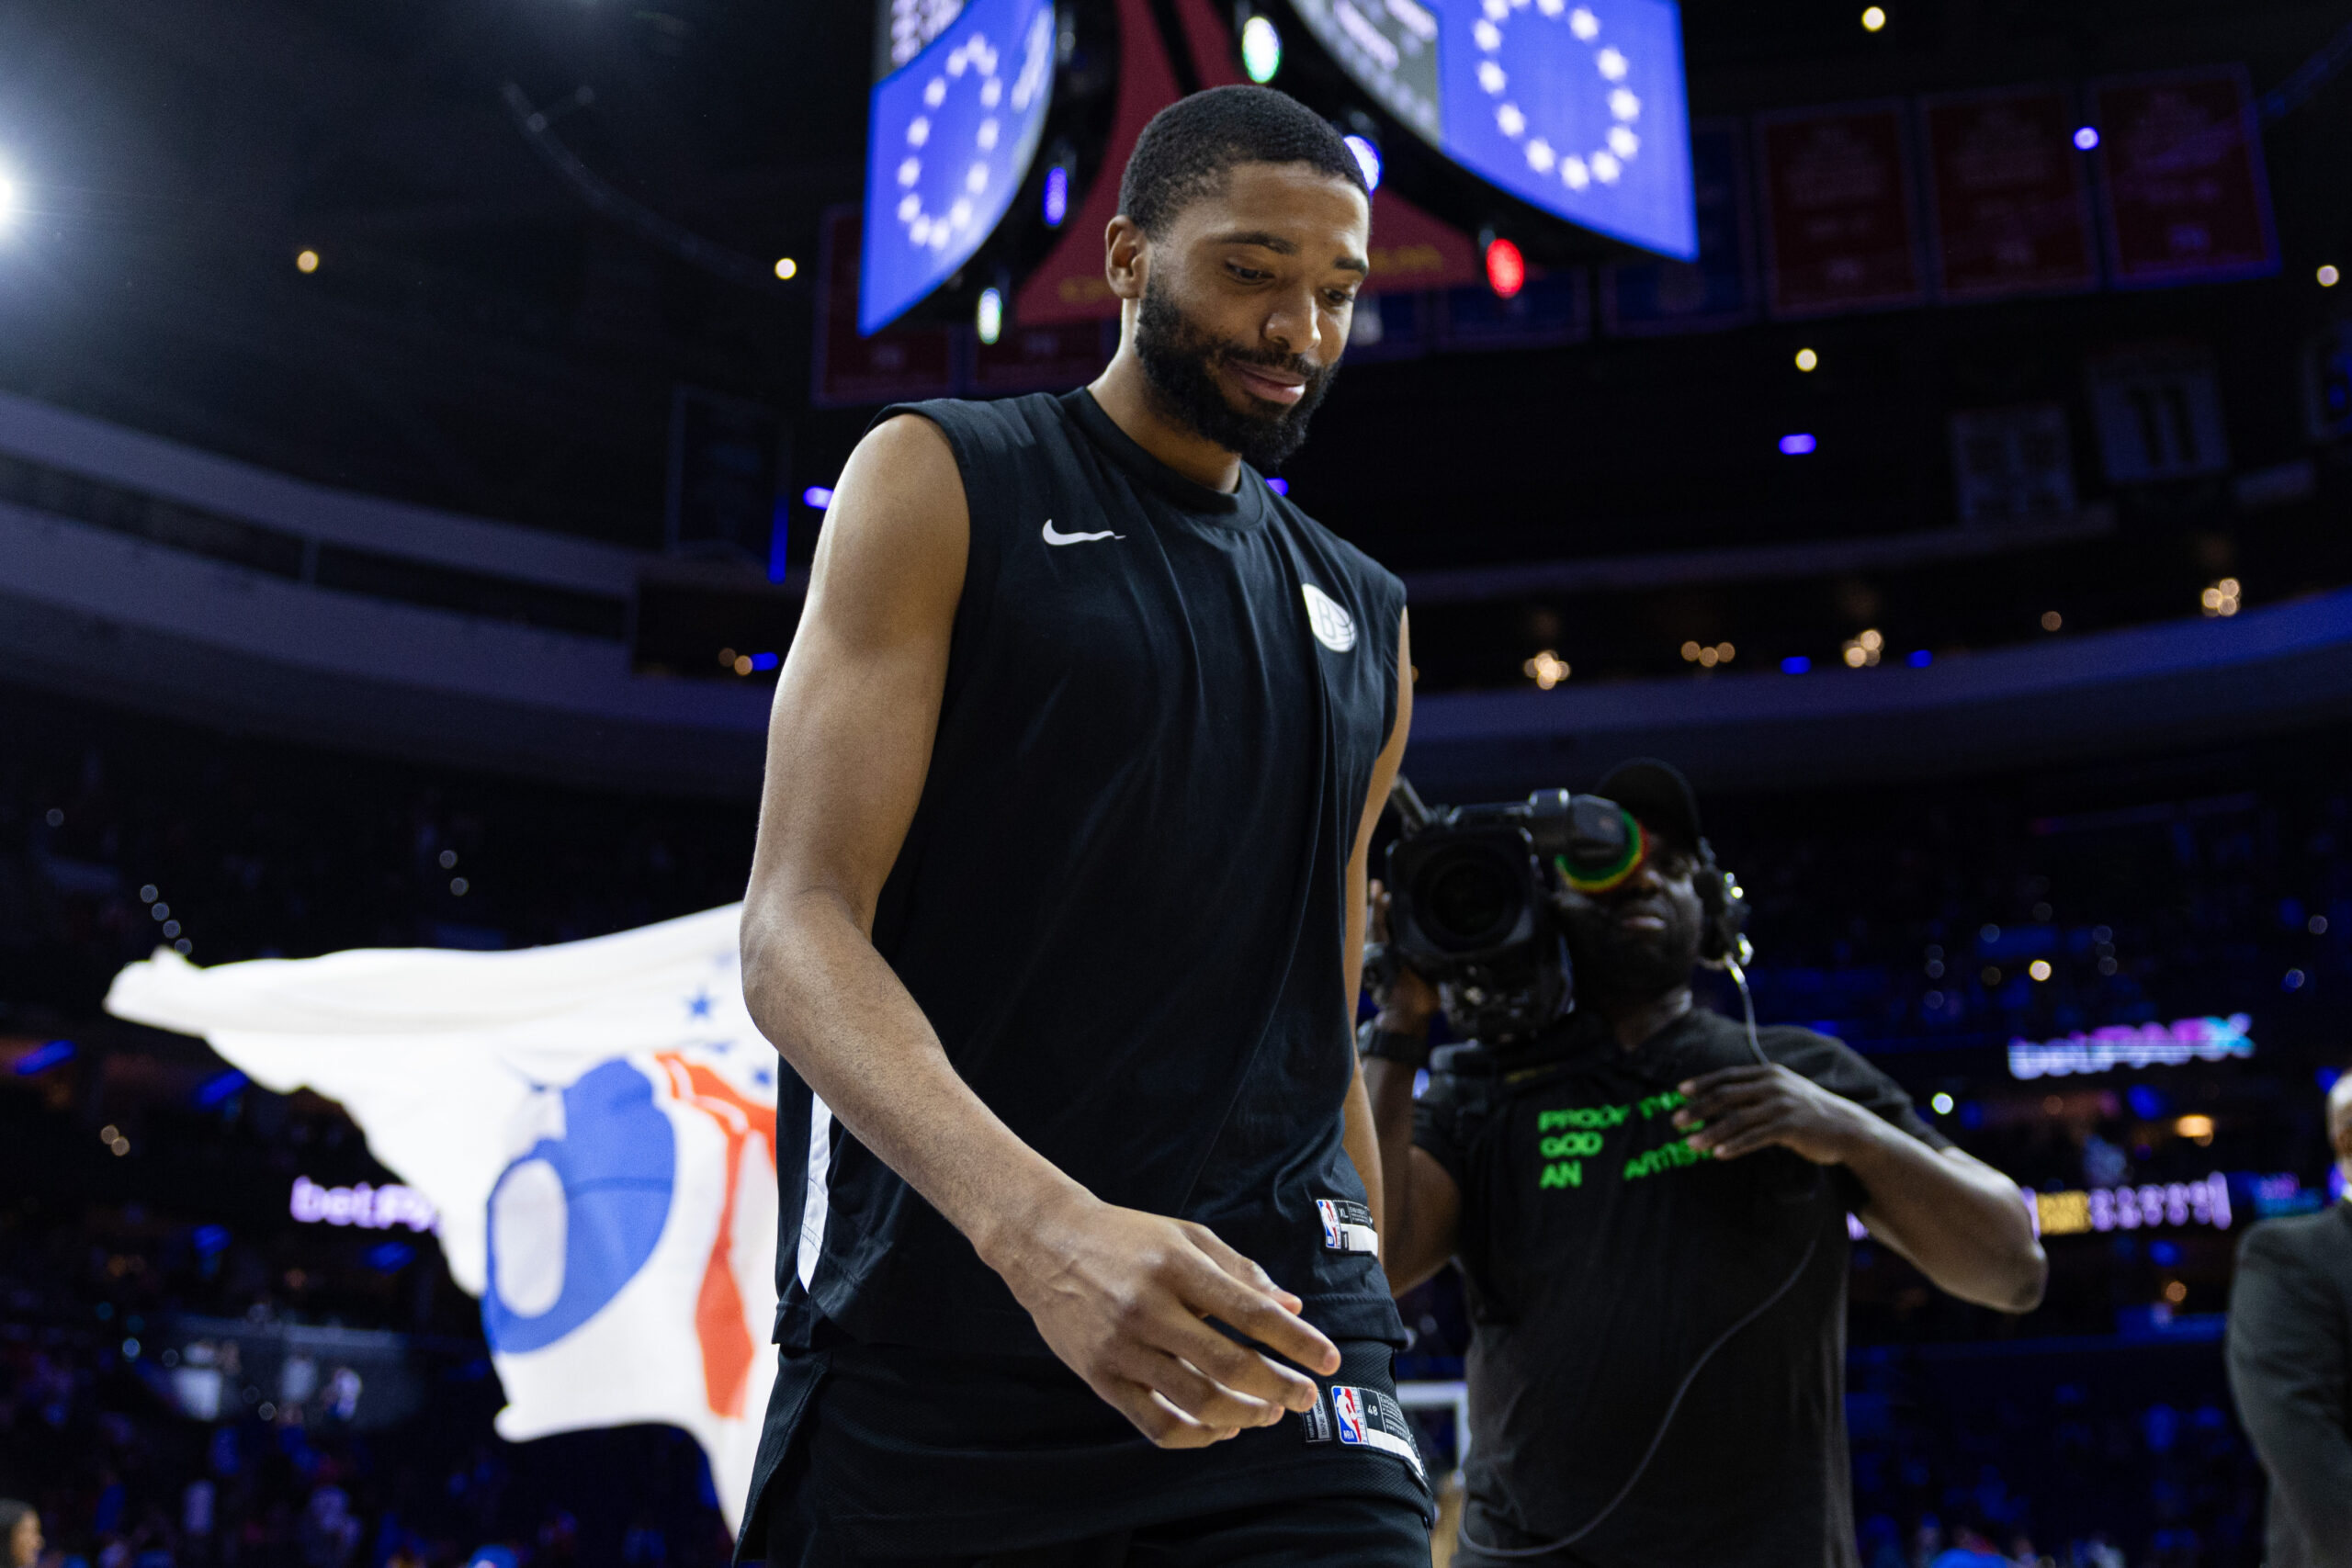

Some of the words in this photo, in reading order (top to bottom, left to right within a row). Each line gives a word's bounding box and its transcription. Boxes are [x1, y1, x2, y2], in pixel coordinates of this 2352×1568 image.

[1539, 1105, 1630, 1132] PROOF
[1539, 1131, 1604, 1158] GOD
[1539, 1159, 1583, 1188] AN
[1338, 1207, 1349, 1219] XL
[1367, 1404, 1379, 1416] 48
